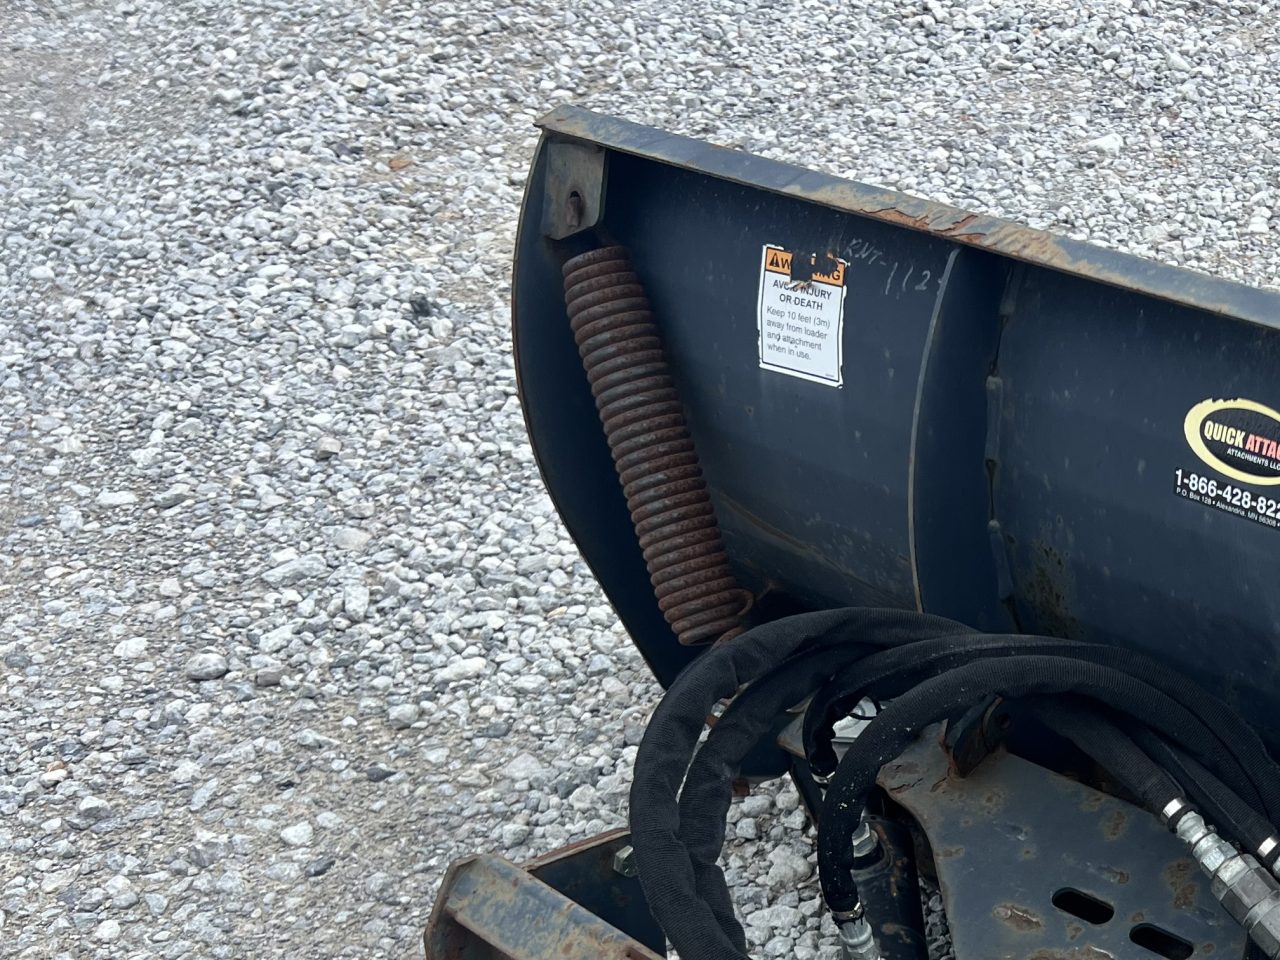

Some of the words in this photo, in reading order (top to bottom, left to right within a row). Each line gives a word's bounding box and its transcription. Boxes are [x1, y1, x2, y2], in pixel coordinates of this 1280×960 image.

[800, 284, 832, 300] INJURY
[779, 294, 792, 304] OR
[793, 297, 823, 311] DEATH
[767, 306, 786, 318] Keep
[788, 311, 797, 320] 10
[798, 312, 812, 324] feet
[814, 317, 831, 329] (3m)
[766, 319, 785, 331] away
[786, 323, 803, 333] from
[804, 327, 828, 340] loader
[767, 331, 781, 342] and
[782, 334, 822, 350] attachment
[767, 343, 787, 354] when
[788, 347, 795, 356] in
[796, 351, 812, 360] use.
[1204, 420, 1246, 449] QUICK
[1226, 448, 1269, 467] ATTACHMENTS
[1189, 492, 1200, 501] Box
[1247, 510, 1258, 521] MN
